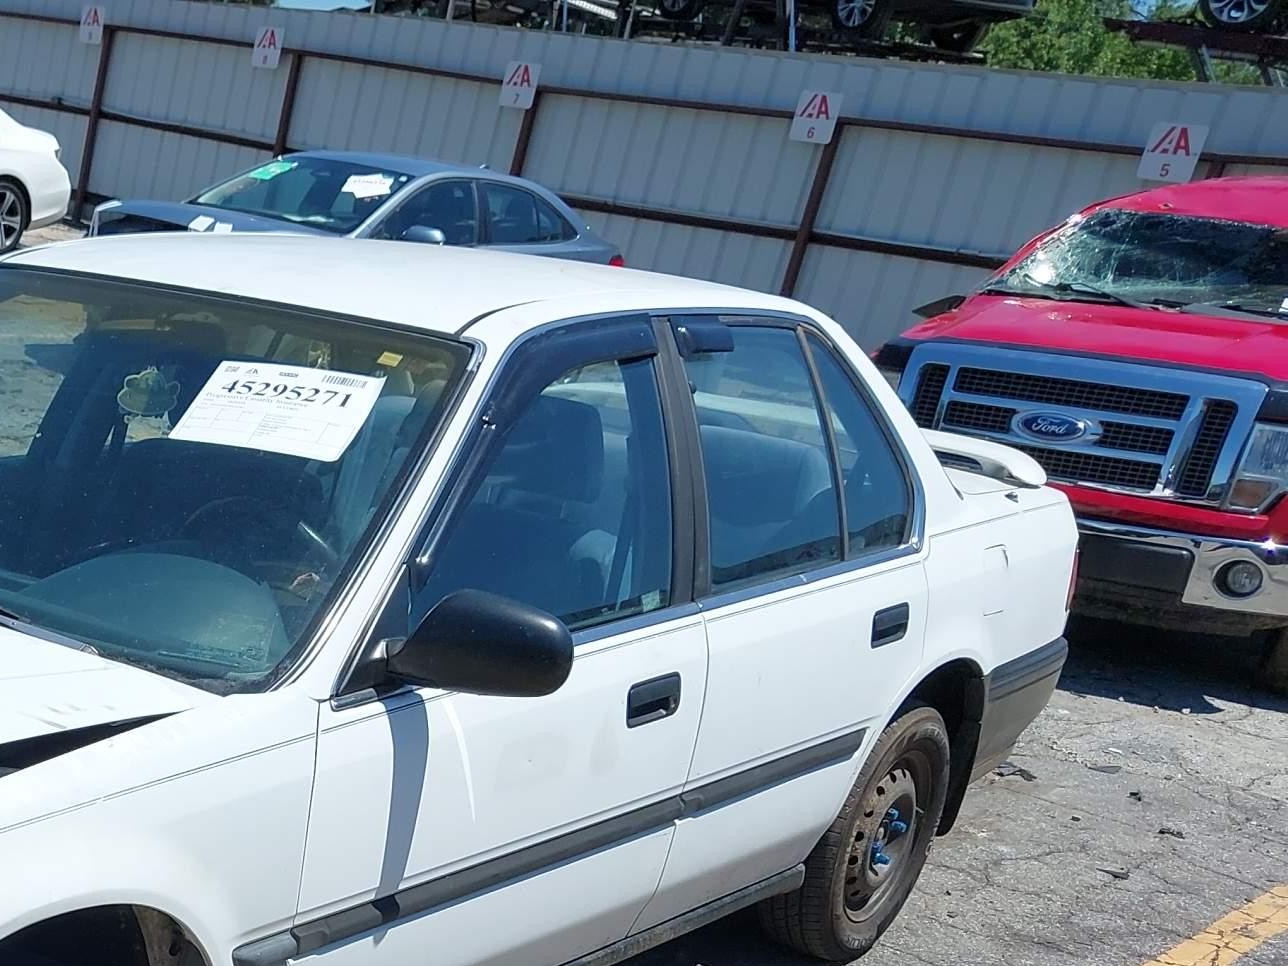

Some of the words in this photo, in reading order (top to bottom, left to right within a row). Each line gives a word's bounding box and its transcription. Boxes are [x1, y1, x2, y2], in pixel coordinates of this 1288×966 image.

[806, 126, 816, 139] 6
[1159, 163, 1171, 178] 5
[222, 379, 352, 408] 45295271
[1032, 416, 1069, 434] Ford
